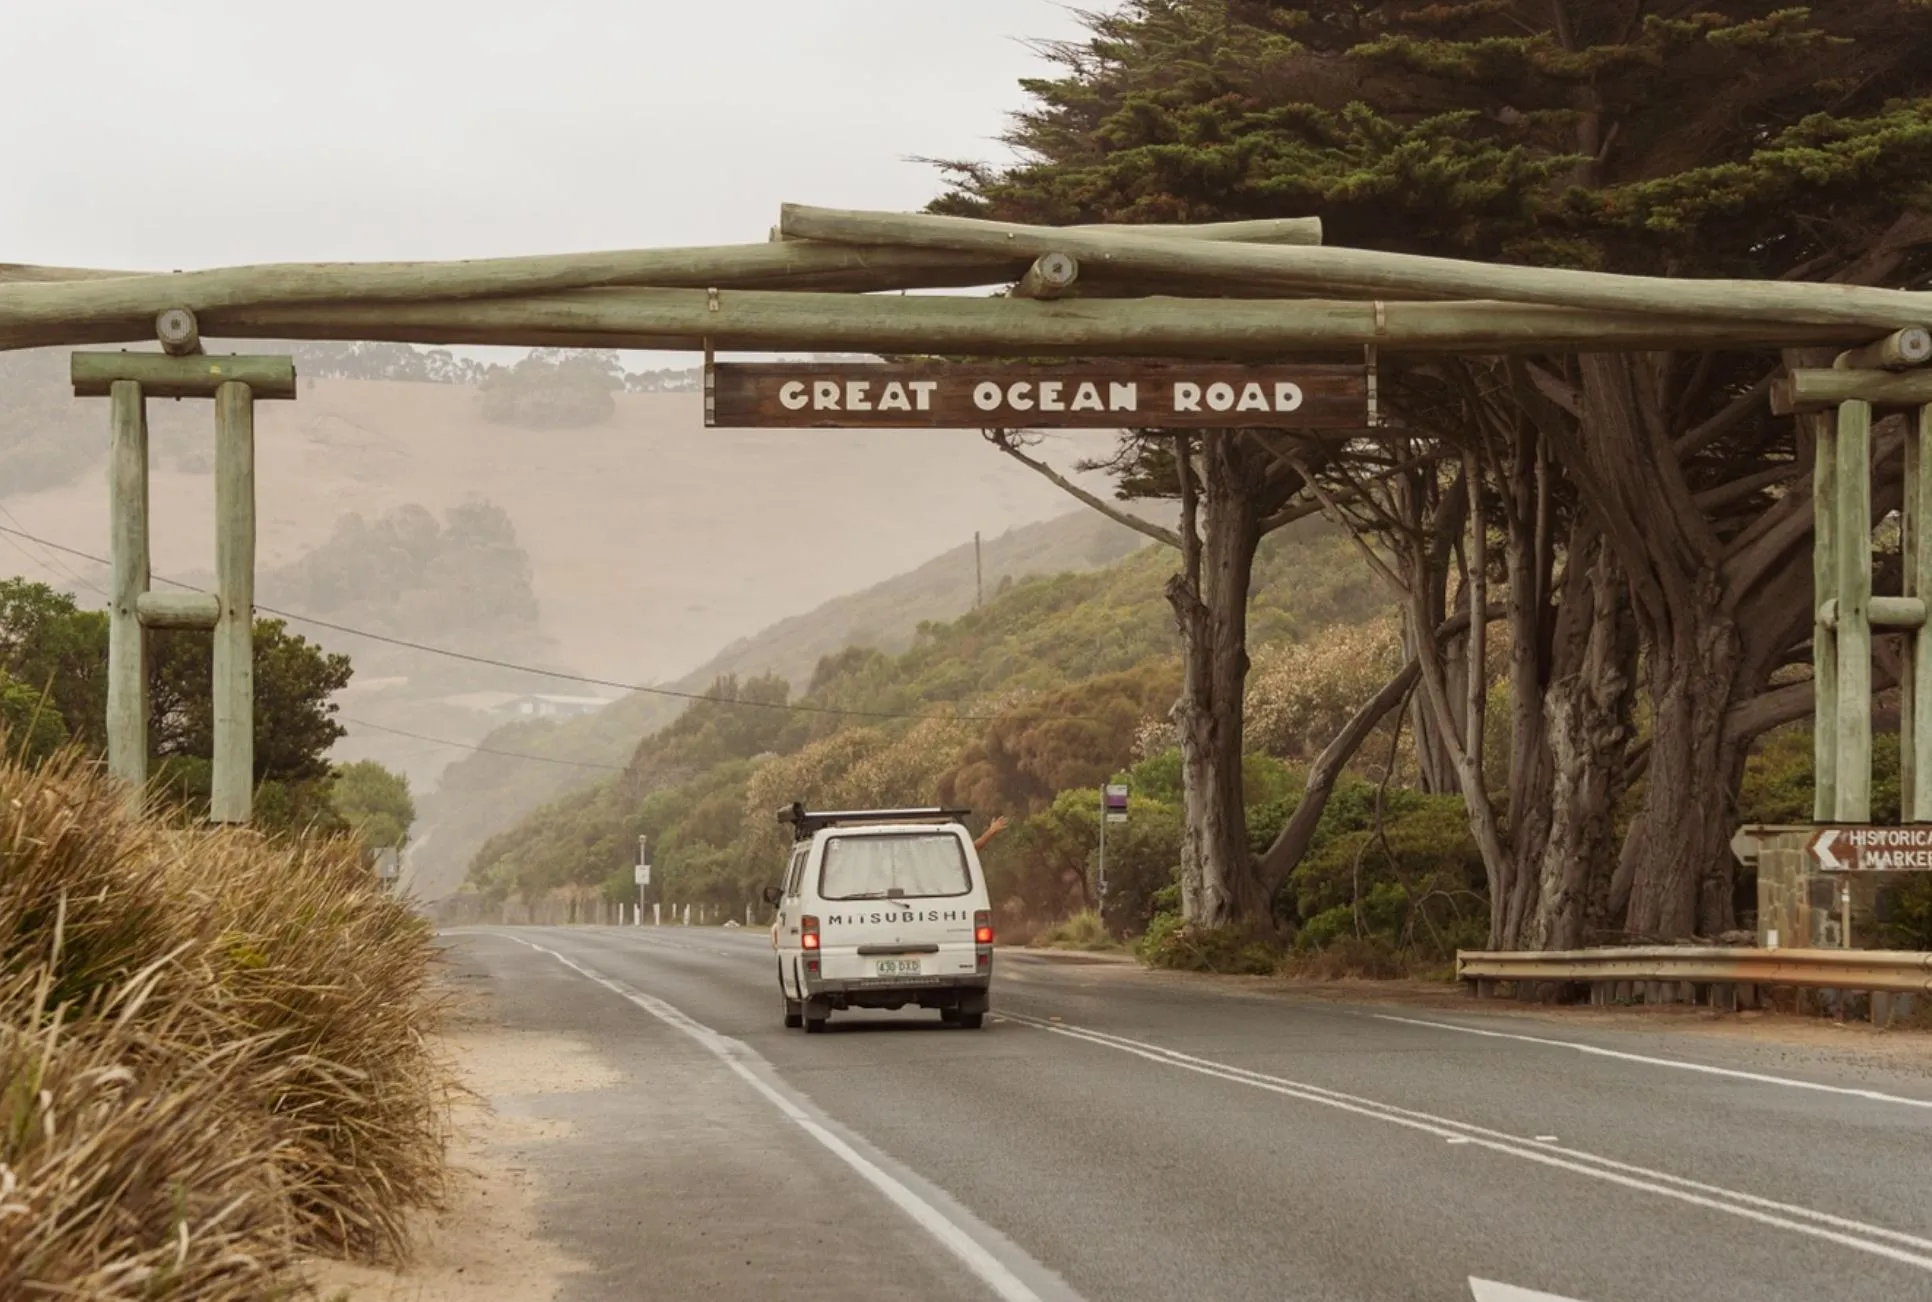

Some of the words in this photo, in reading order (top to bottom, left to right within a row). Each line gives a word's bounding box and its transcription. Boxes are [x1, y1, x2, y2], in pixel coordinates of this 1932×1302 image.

[779, 381, 937, 411] GREAT
[973, 381, 1137, 411] OCEAN
[1174, 382, 1303, 411] ROAD
